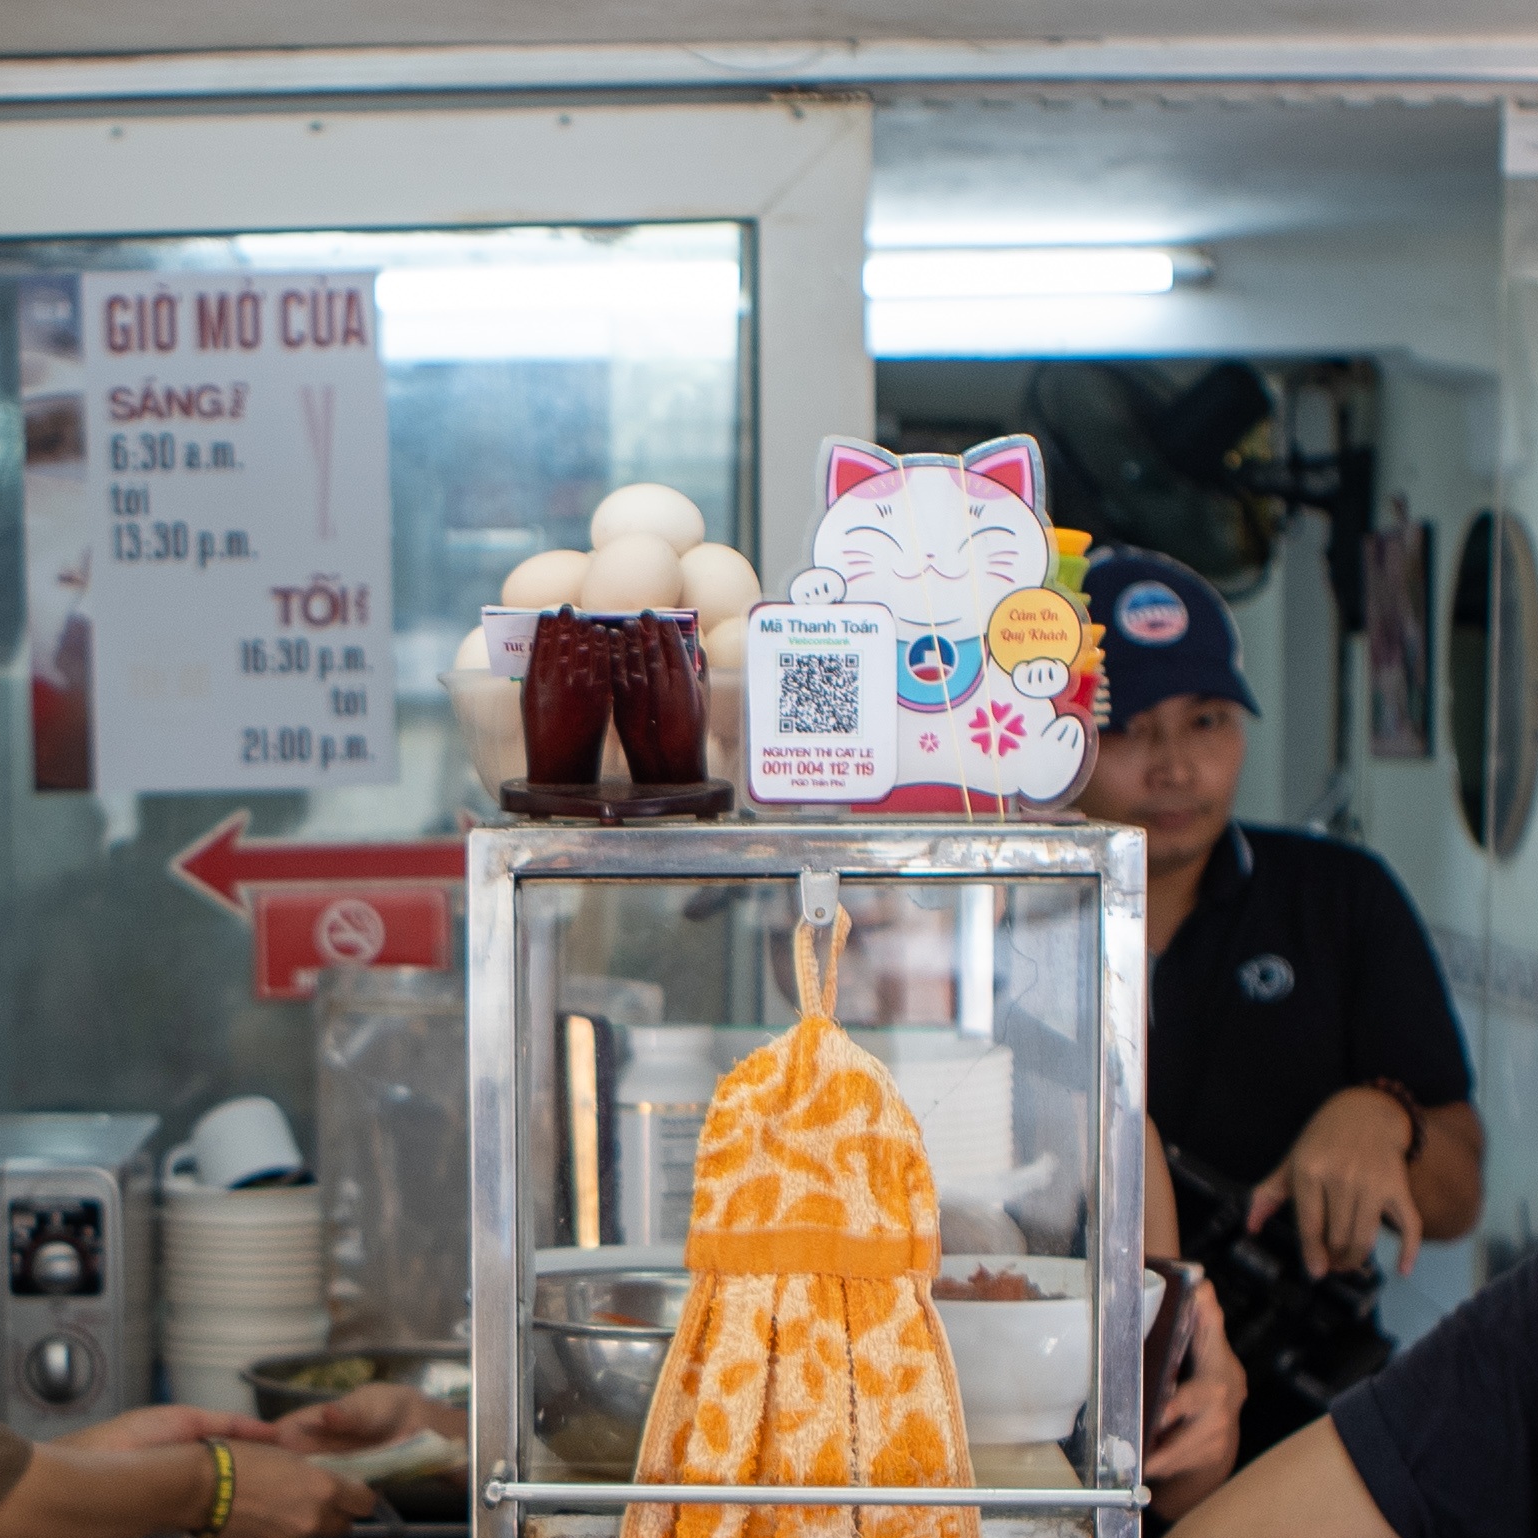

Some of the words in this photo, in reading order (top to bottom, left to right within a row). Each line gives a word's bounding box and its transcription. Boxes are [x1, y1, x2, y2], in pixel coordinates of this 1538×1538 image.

[109, 377, 224, 420] SÁNG
[111, 432, 175, 470] 6:30
[185, 440, 243, 469] a.m.
[114, 520, 188, 561] 13:30
[198, 530, 258, 568] p.m.
[760, 618, 783, 633] Mã
[788, 619, 836, 633] Thanh
[841, 618, 879, 634] Toán
[241, 637, 310, 673] 16:30
[318, 645, 373, 681] p.m.
[243, 726, 311, 764] 21:00
[320, 734, 375, 770] p.m.
[763, 747, 811, 757] NGUYEN
[815, 747, 833, 757] THI
[835, 748, 857, 758] CAT
[859, 748, 874, 758] LE
[763, 761, 792, 775] 0011
[797, 761, 823, 775] 004
[830, 761, 849, 775] 112
[854, 761, 874, 775] 119
